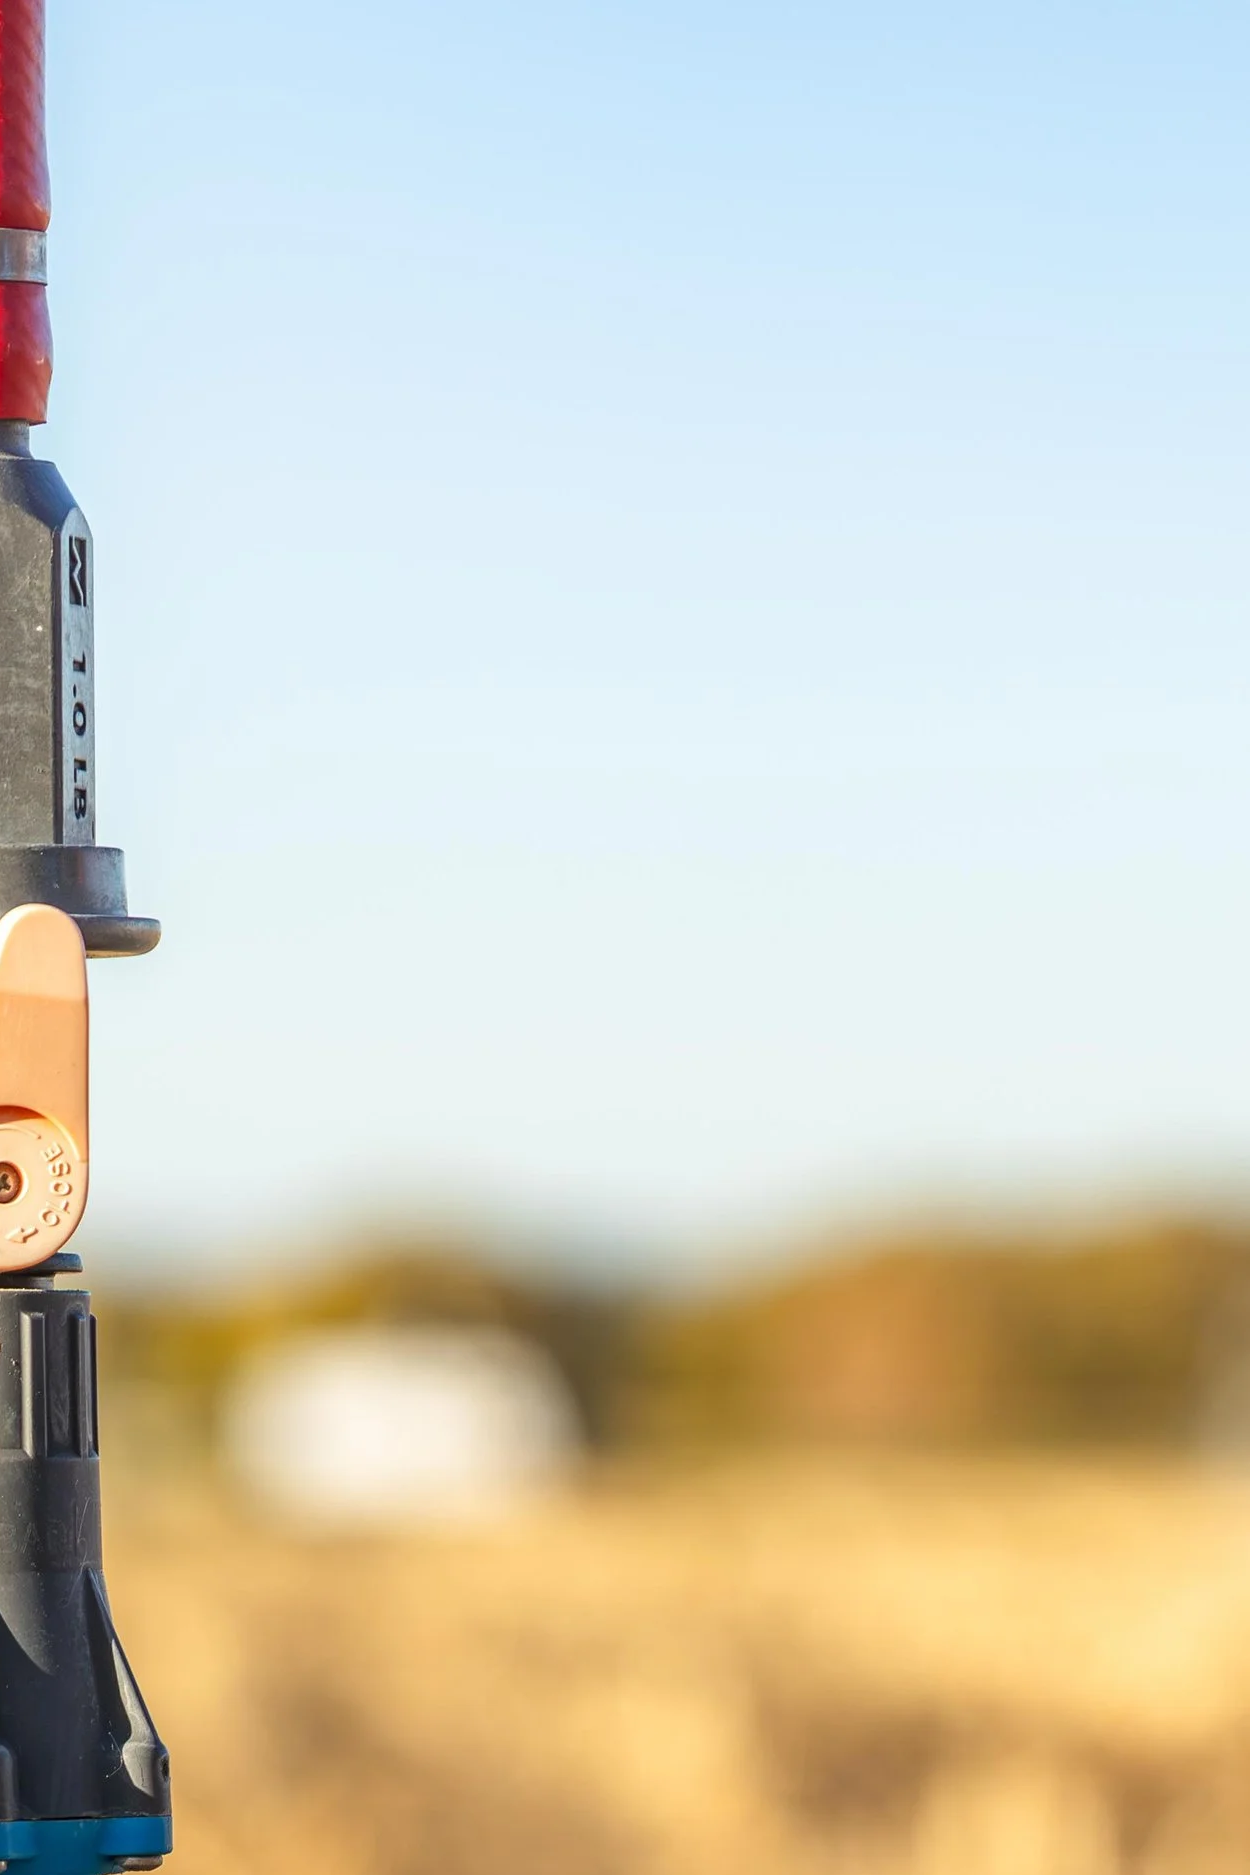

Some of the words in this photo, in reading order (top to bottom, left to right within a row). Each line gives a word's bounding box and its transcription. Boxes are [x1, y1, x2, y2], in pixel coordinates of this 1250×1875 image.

[72, 650, 87, 736] 1.0
[73, 758, 88, 820] LB
[38, 1141, 73, 1227] CLOSE
